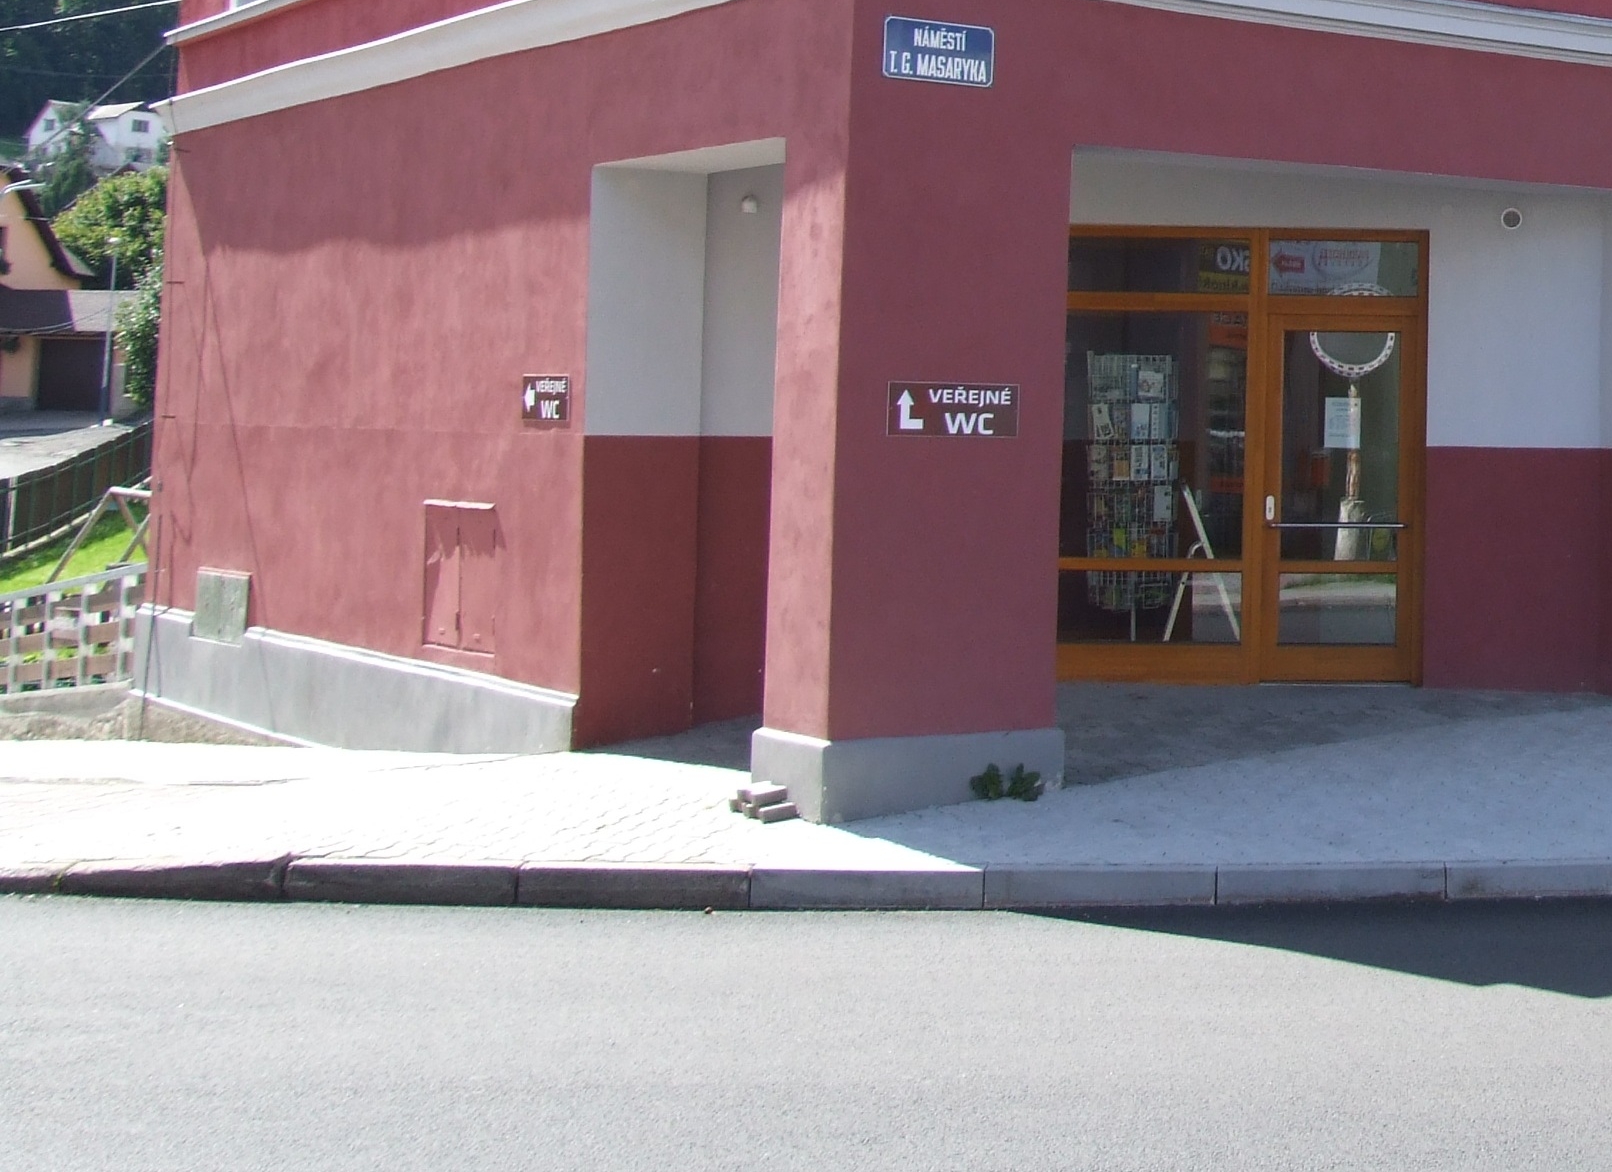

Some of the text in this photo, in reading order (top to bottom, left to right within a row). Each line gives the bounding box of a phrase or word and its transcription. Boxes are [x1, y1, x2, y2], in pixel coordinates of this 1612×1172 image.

[913, 26, 967, 51] NÁMĚSTÍ
[889, 50, 987, 83] T. G. MASARYKA
[929, 386, 1012, 408] VEŘEJNÉ
[540, 400, 560, 419] WC
[944, 412, 994, 435] WC
